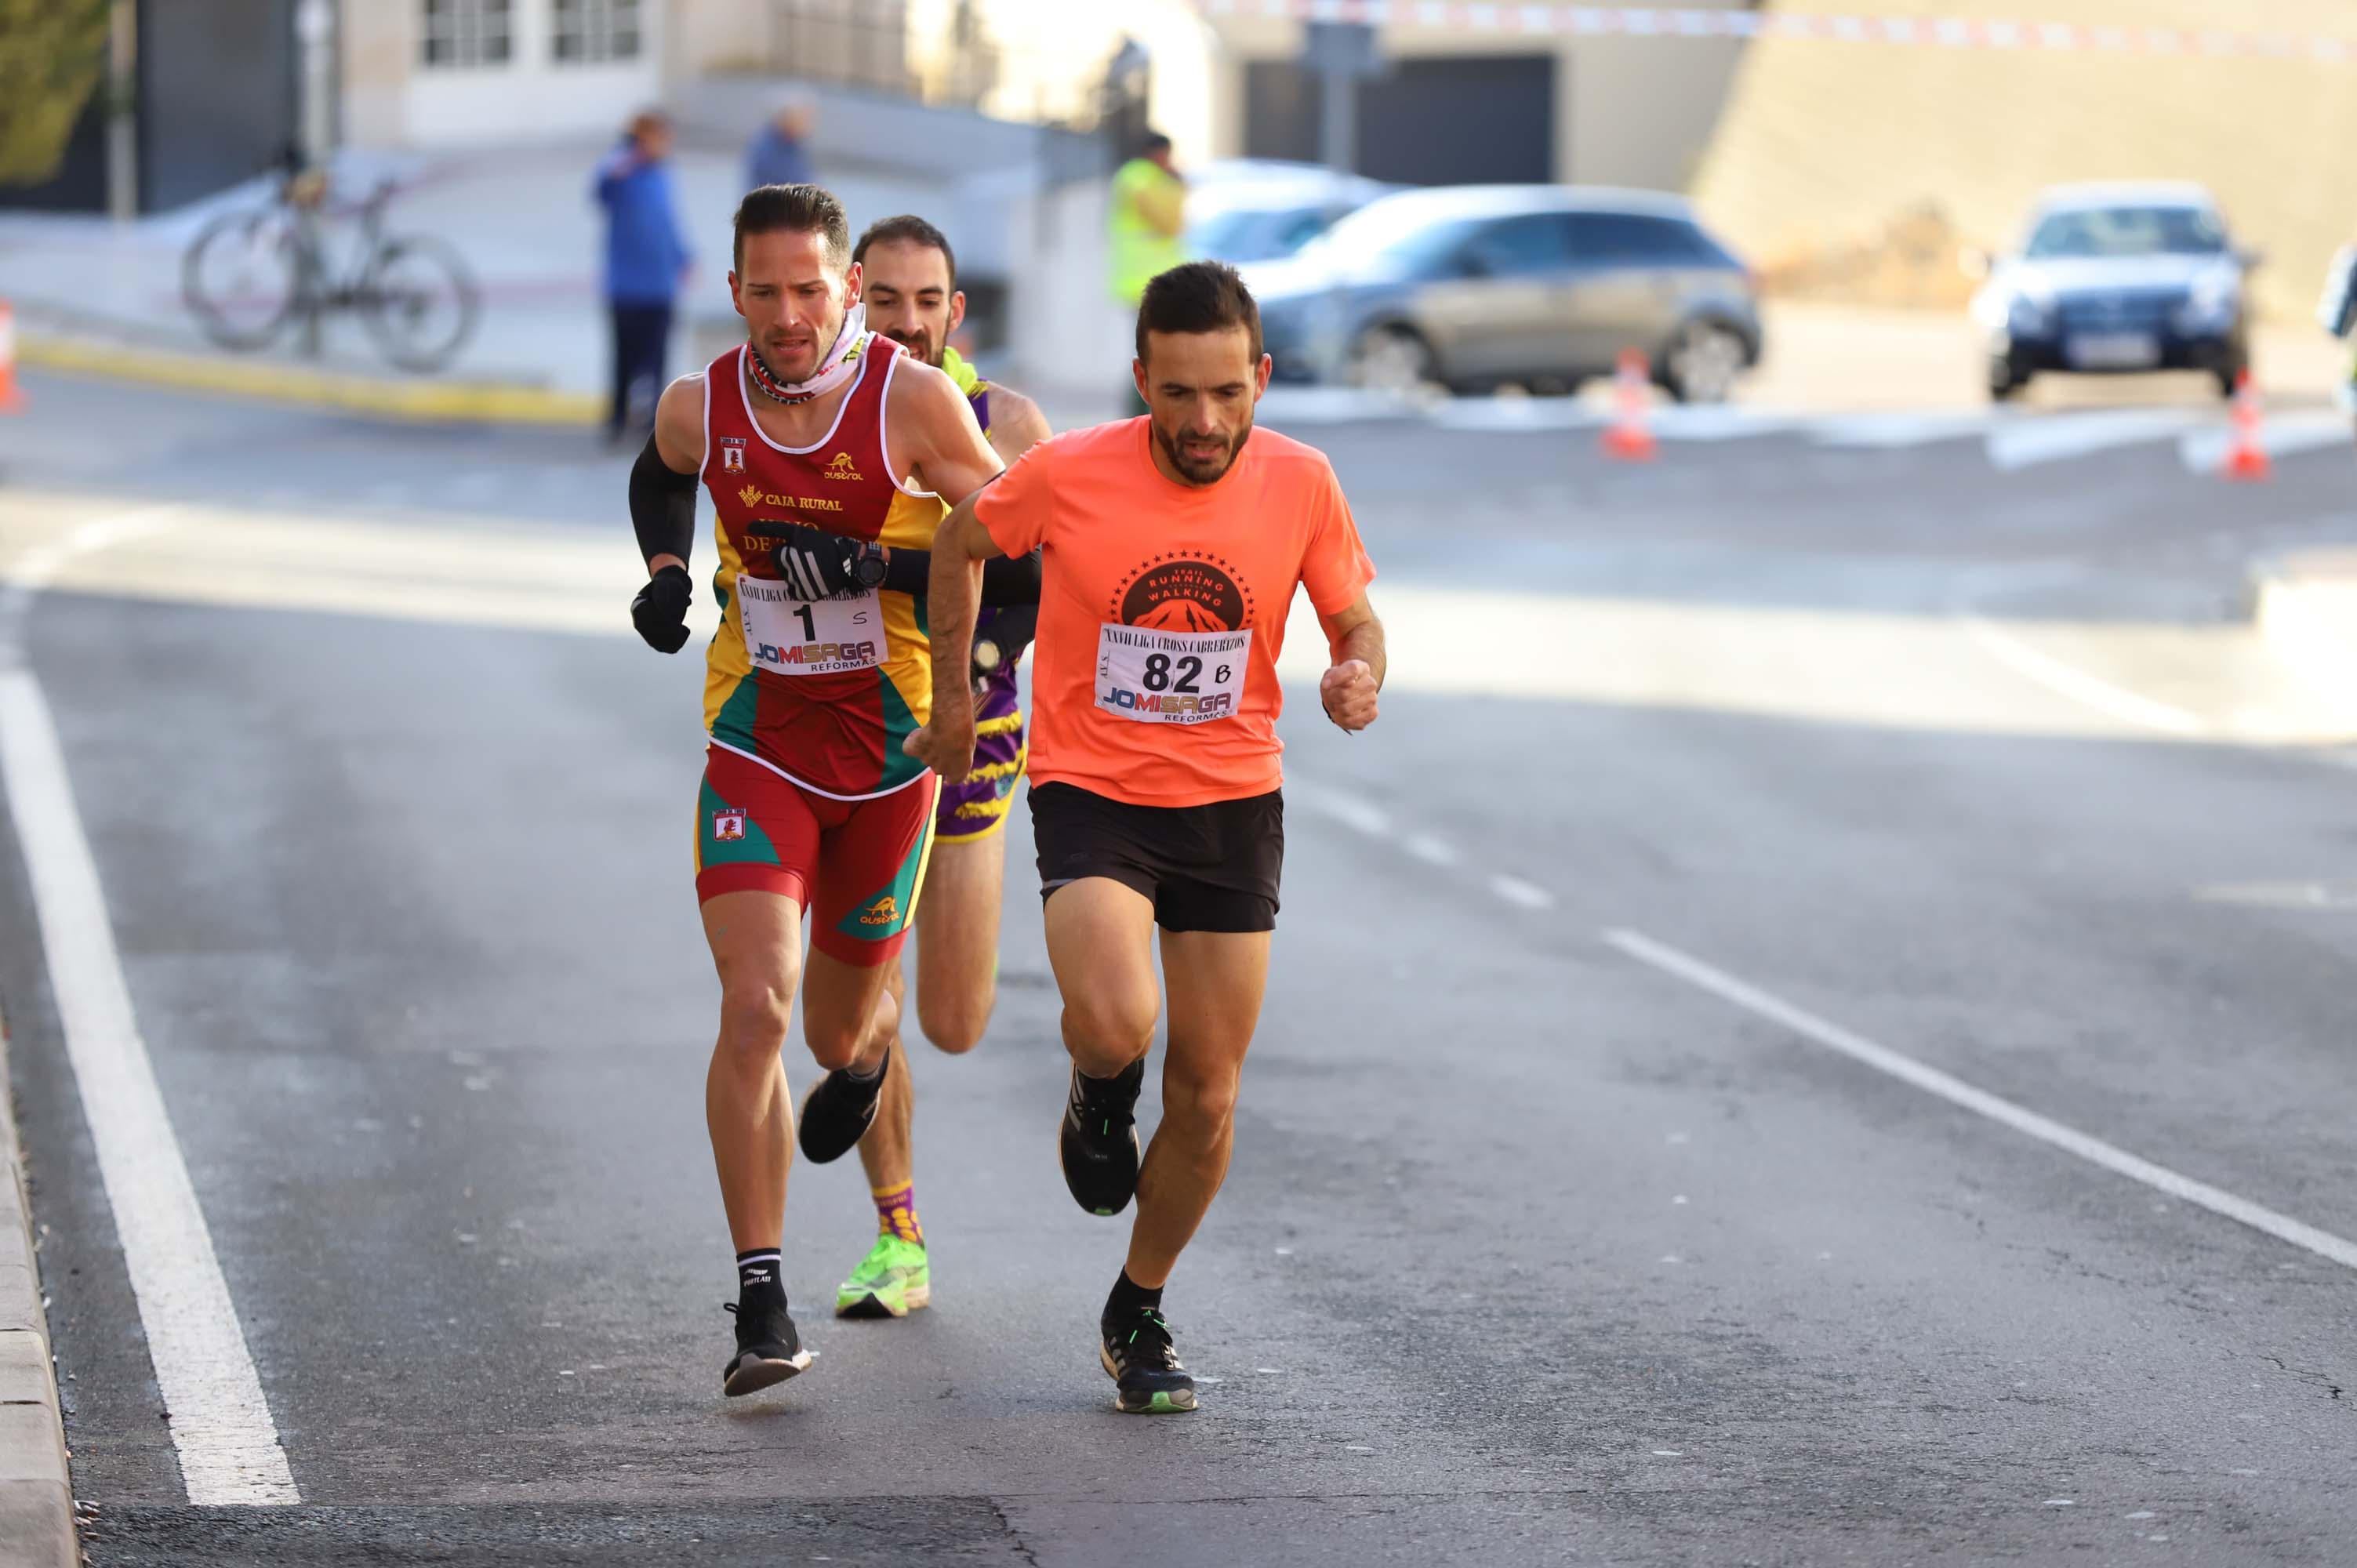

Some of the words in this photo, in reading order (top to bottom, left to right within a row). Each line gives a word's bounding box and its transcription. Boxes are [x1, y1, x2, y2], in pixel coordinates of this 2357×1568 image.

[765, 494, 797, 507] CAJA
[799, 497, 844, 511] RURAL
[1149, 575, 1224, 592] RUNNING
[1149, 588, 1222, 606] WALKING
[793, 604, 816, 642] 1
[755, 641, 876, 664] JOMISAGA
[1134, 633, 1155, 649] LIGA
[1158, 637, 1188, 652] CROSS
[1189, 635, 1246, 653] CABRERIZOS
[811, 658, 877, 672] REFORMAS
[1142, 653, 1203, 693] 82
[1103, 687, 1231, 714] JOMISAGA
